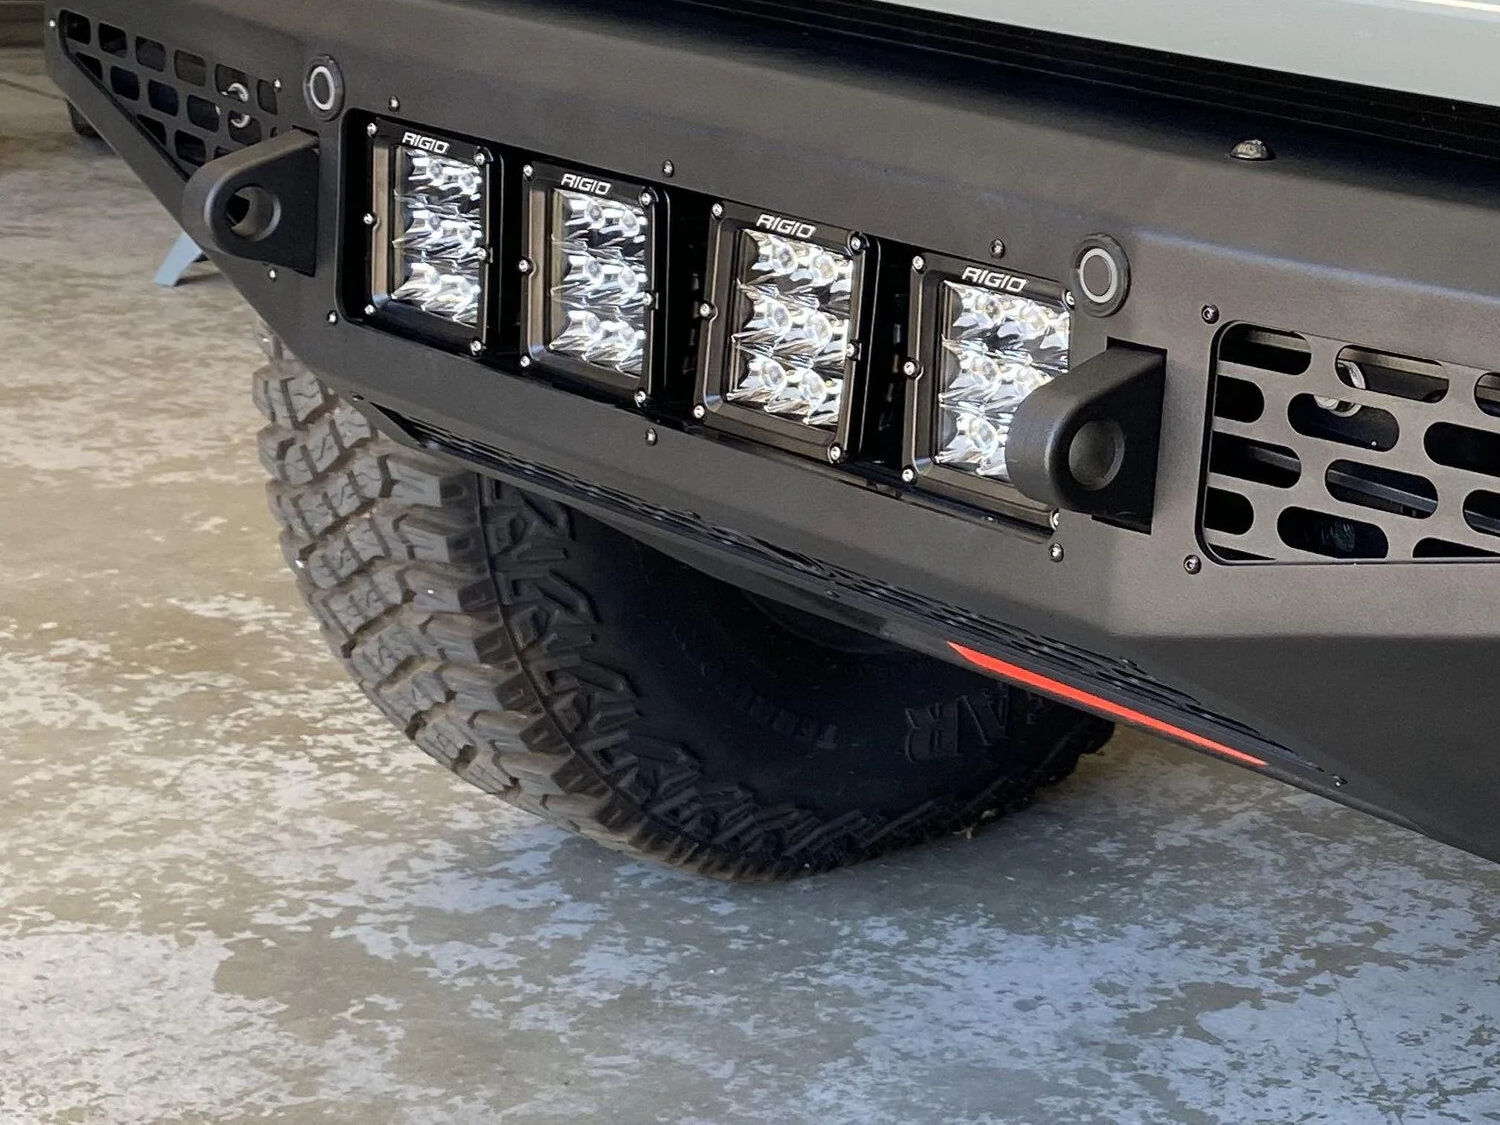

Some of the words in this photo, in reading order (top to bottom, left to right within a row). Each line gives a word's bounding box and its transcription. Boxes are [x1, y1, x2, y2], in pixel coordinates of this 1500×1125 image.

[402, 131, 450, 154] RIGID
[561, 173, 611, 195] RIGID
[756, 213, 817, 239] RIGID
[961, 266, 1028, 293] RIGID
